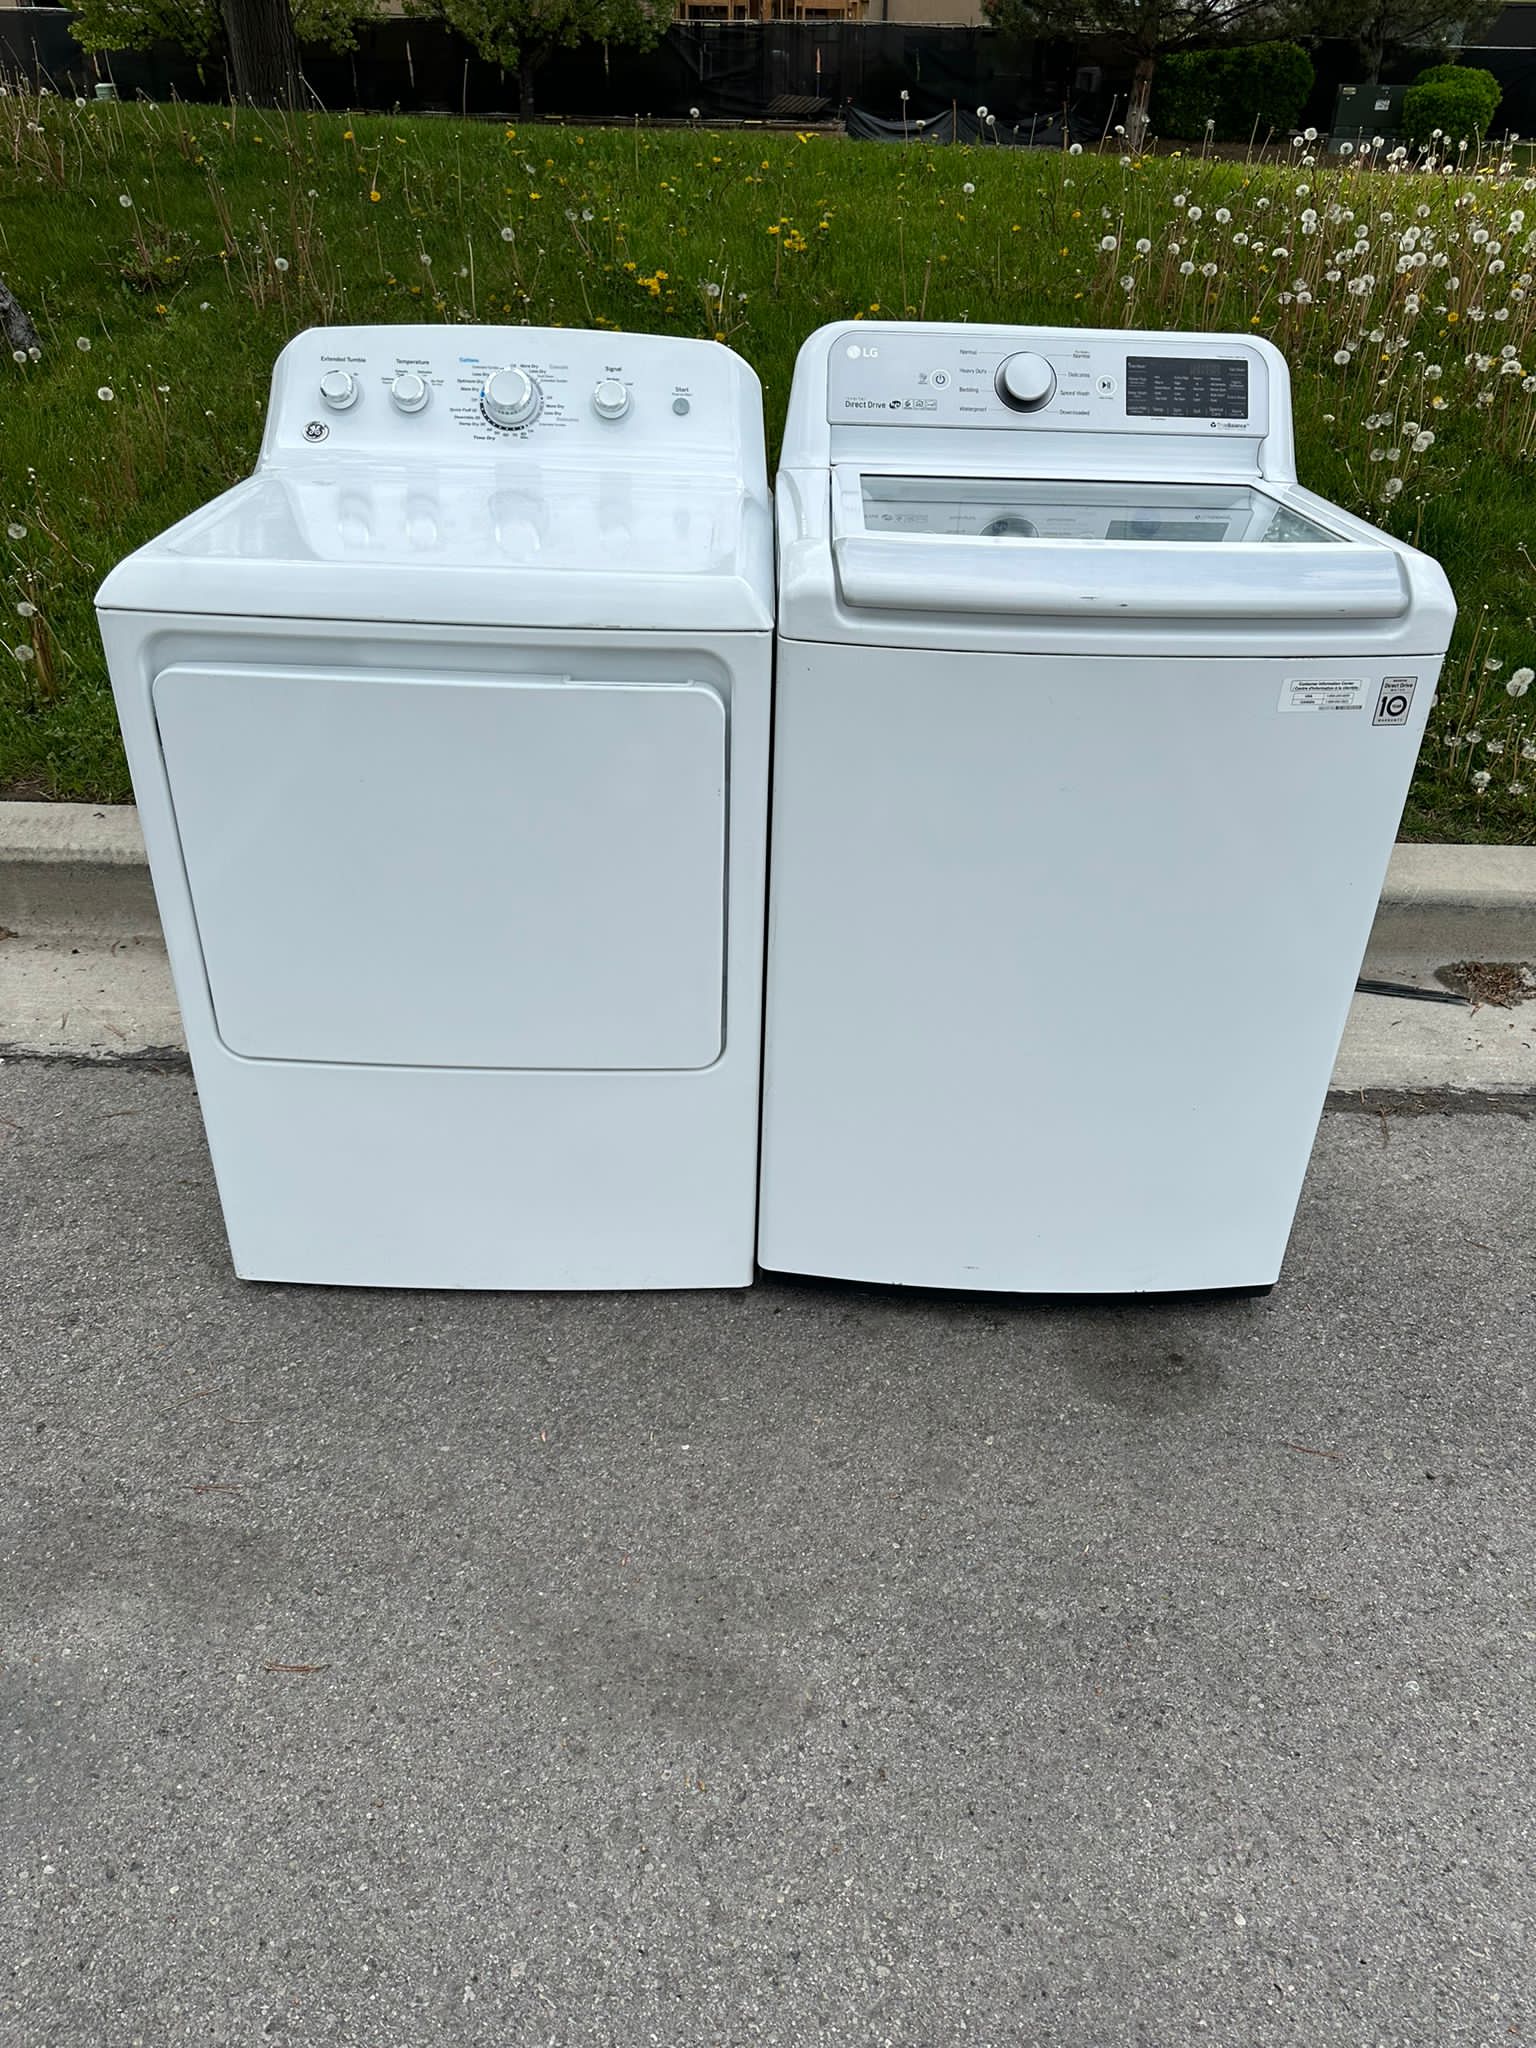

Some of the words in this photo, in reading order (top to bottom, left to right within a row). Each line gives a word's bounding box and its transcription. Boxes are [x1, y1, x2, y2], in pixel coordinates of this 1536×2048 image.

[862, 347, 879, 358] LG
[845, 400, 866, 408] Direct
[867, 400, 886, 409] Drive
[1379, 695, 1408, 717] 10
